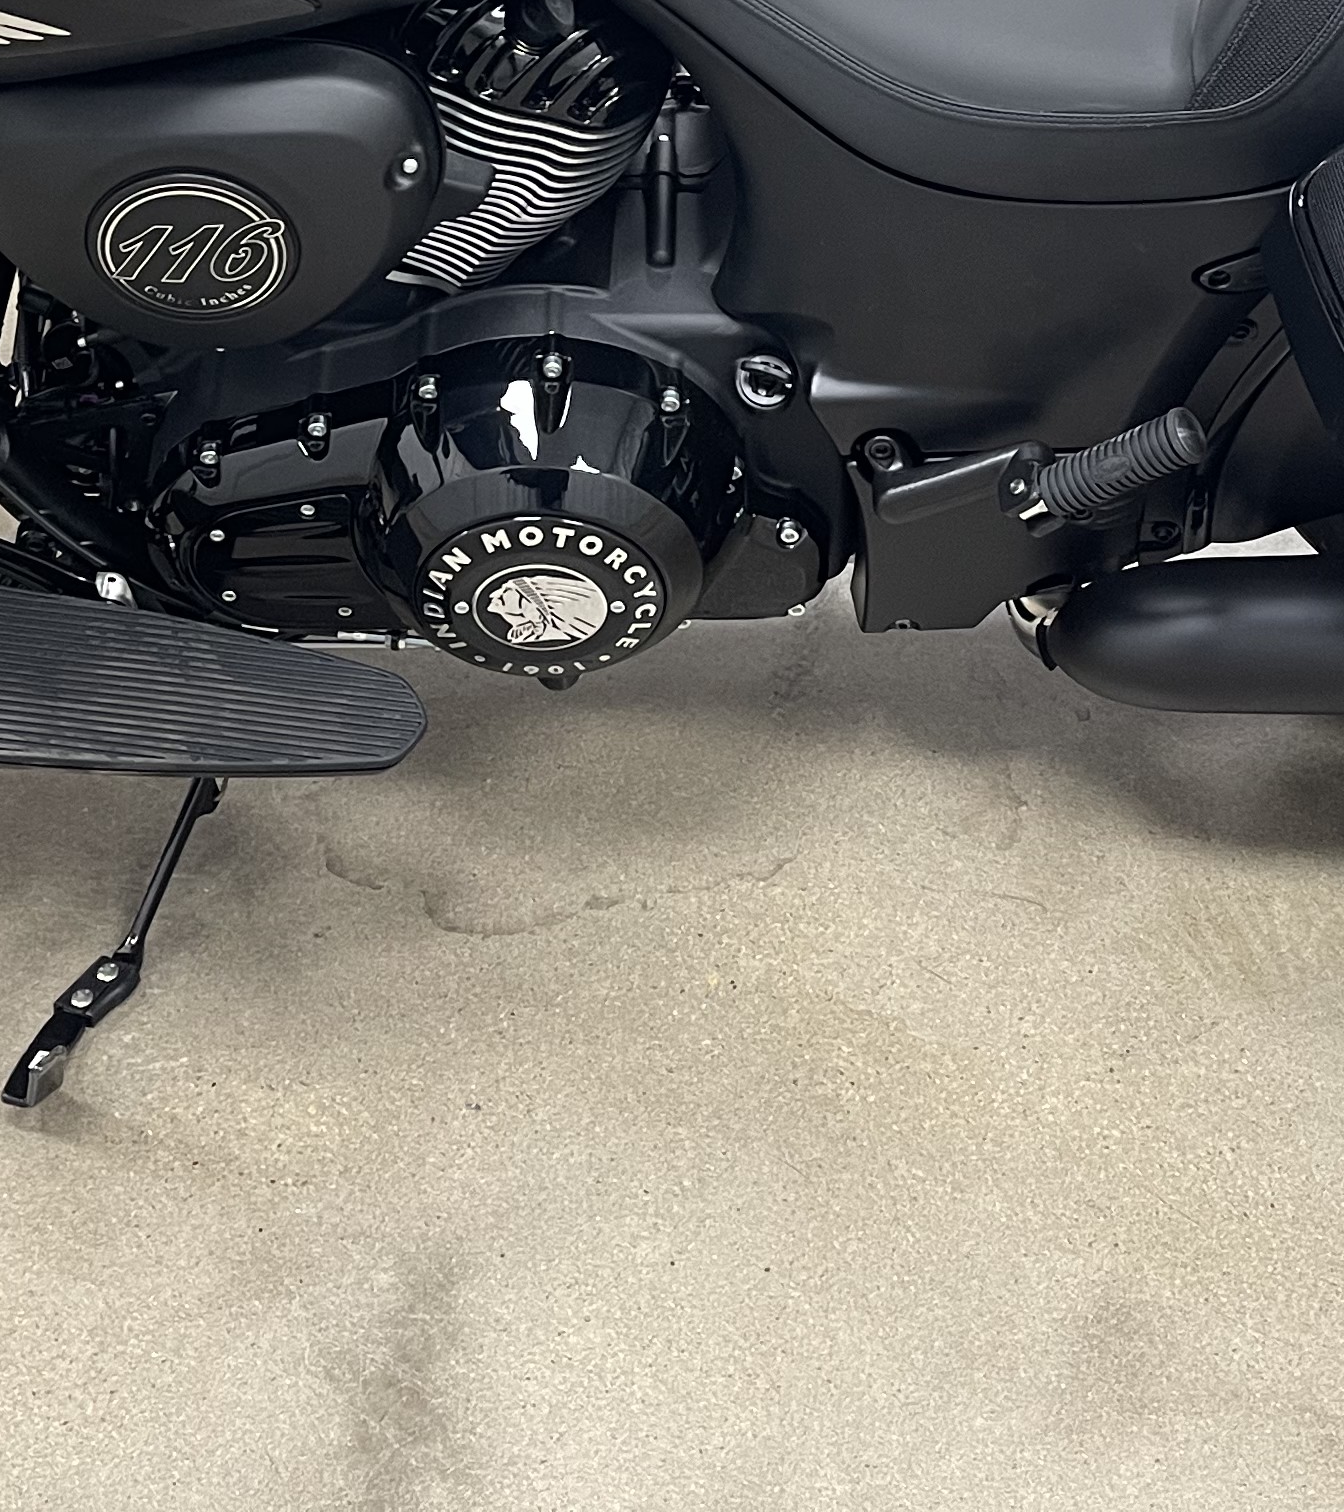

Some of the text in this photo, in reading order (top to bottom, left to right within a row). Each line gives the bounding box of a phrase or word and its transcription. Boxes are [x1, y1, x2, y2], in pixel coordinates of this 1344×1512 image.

[112, 218, 285, 283] 116
[144, 283, 253, 307] Cubic Inches
[423, 526, 657, 649] INDIAN MOTORCYCLE
[502, 661, 586, 675] 1901
